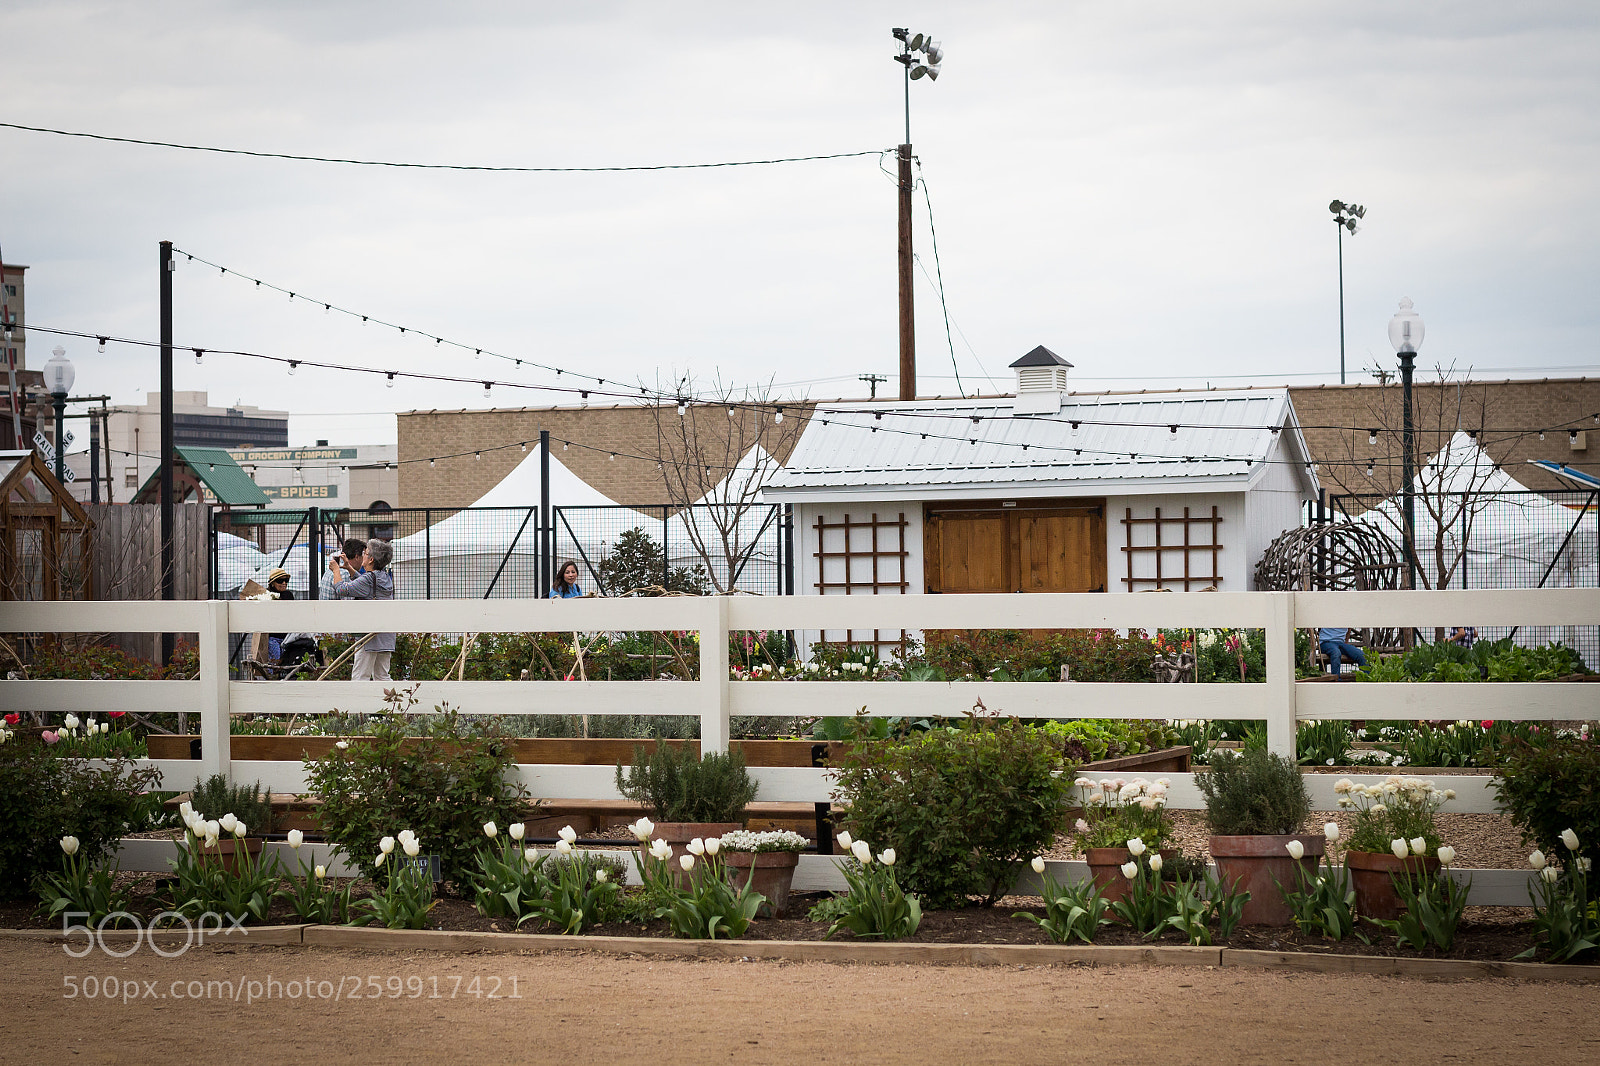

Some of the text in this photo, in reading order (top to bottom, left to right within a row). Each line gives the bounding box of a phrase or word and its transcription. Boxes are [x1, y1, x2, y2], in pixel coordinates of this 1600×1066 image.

[35, 434, 75, 481] RAILOAD
[248, 451, 292, 460] GROCERY
[295, 450, 341, 459] COMPANY
[281, 486, 328, 497] SPICES
